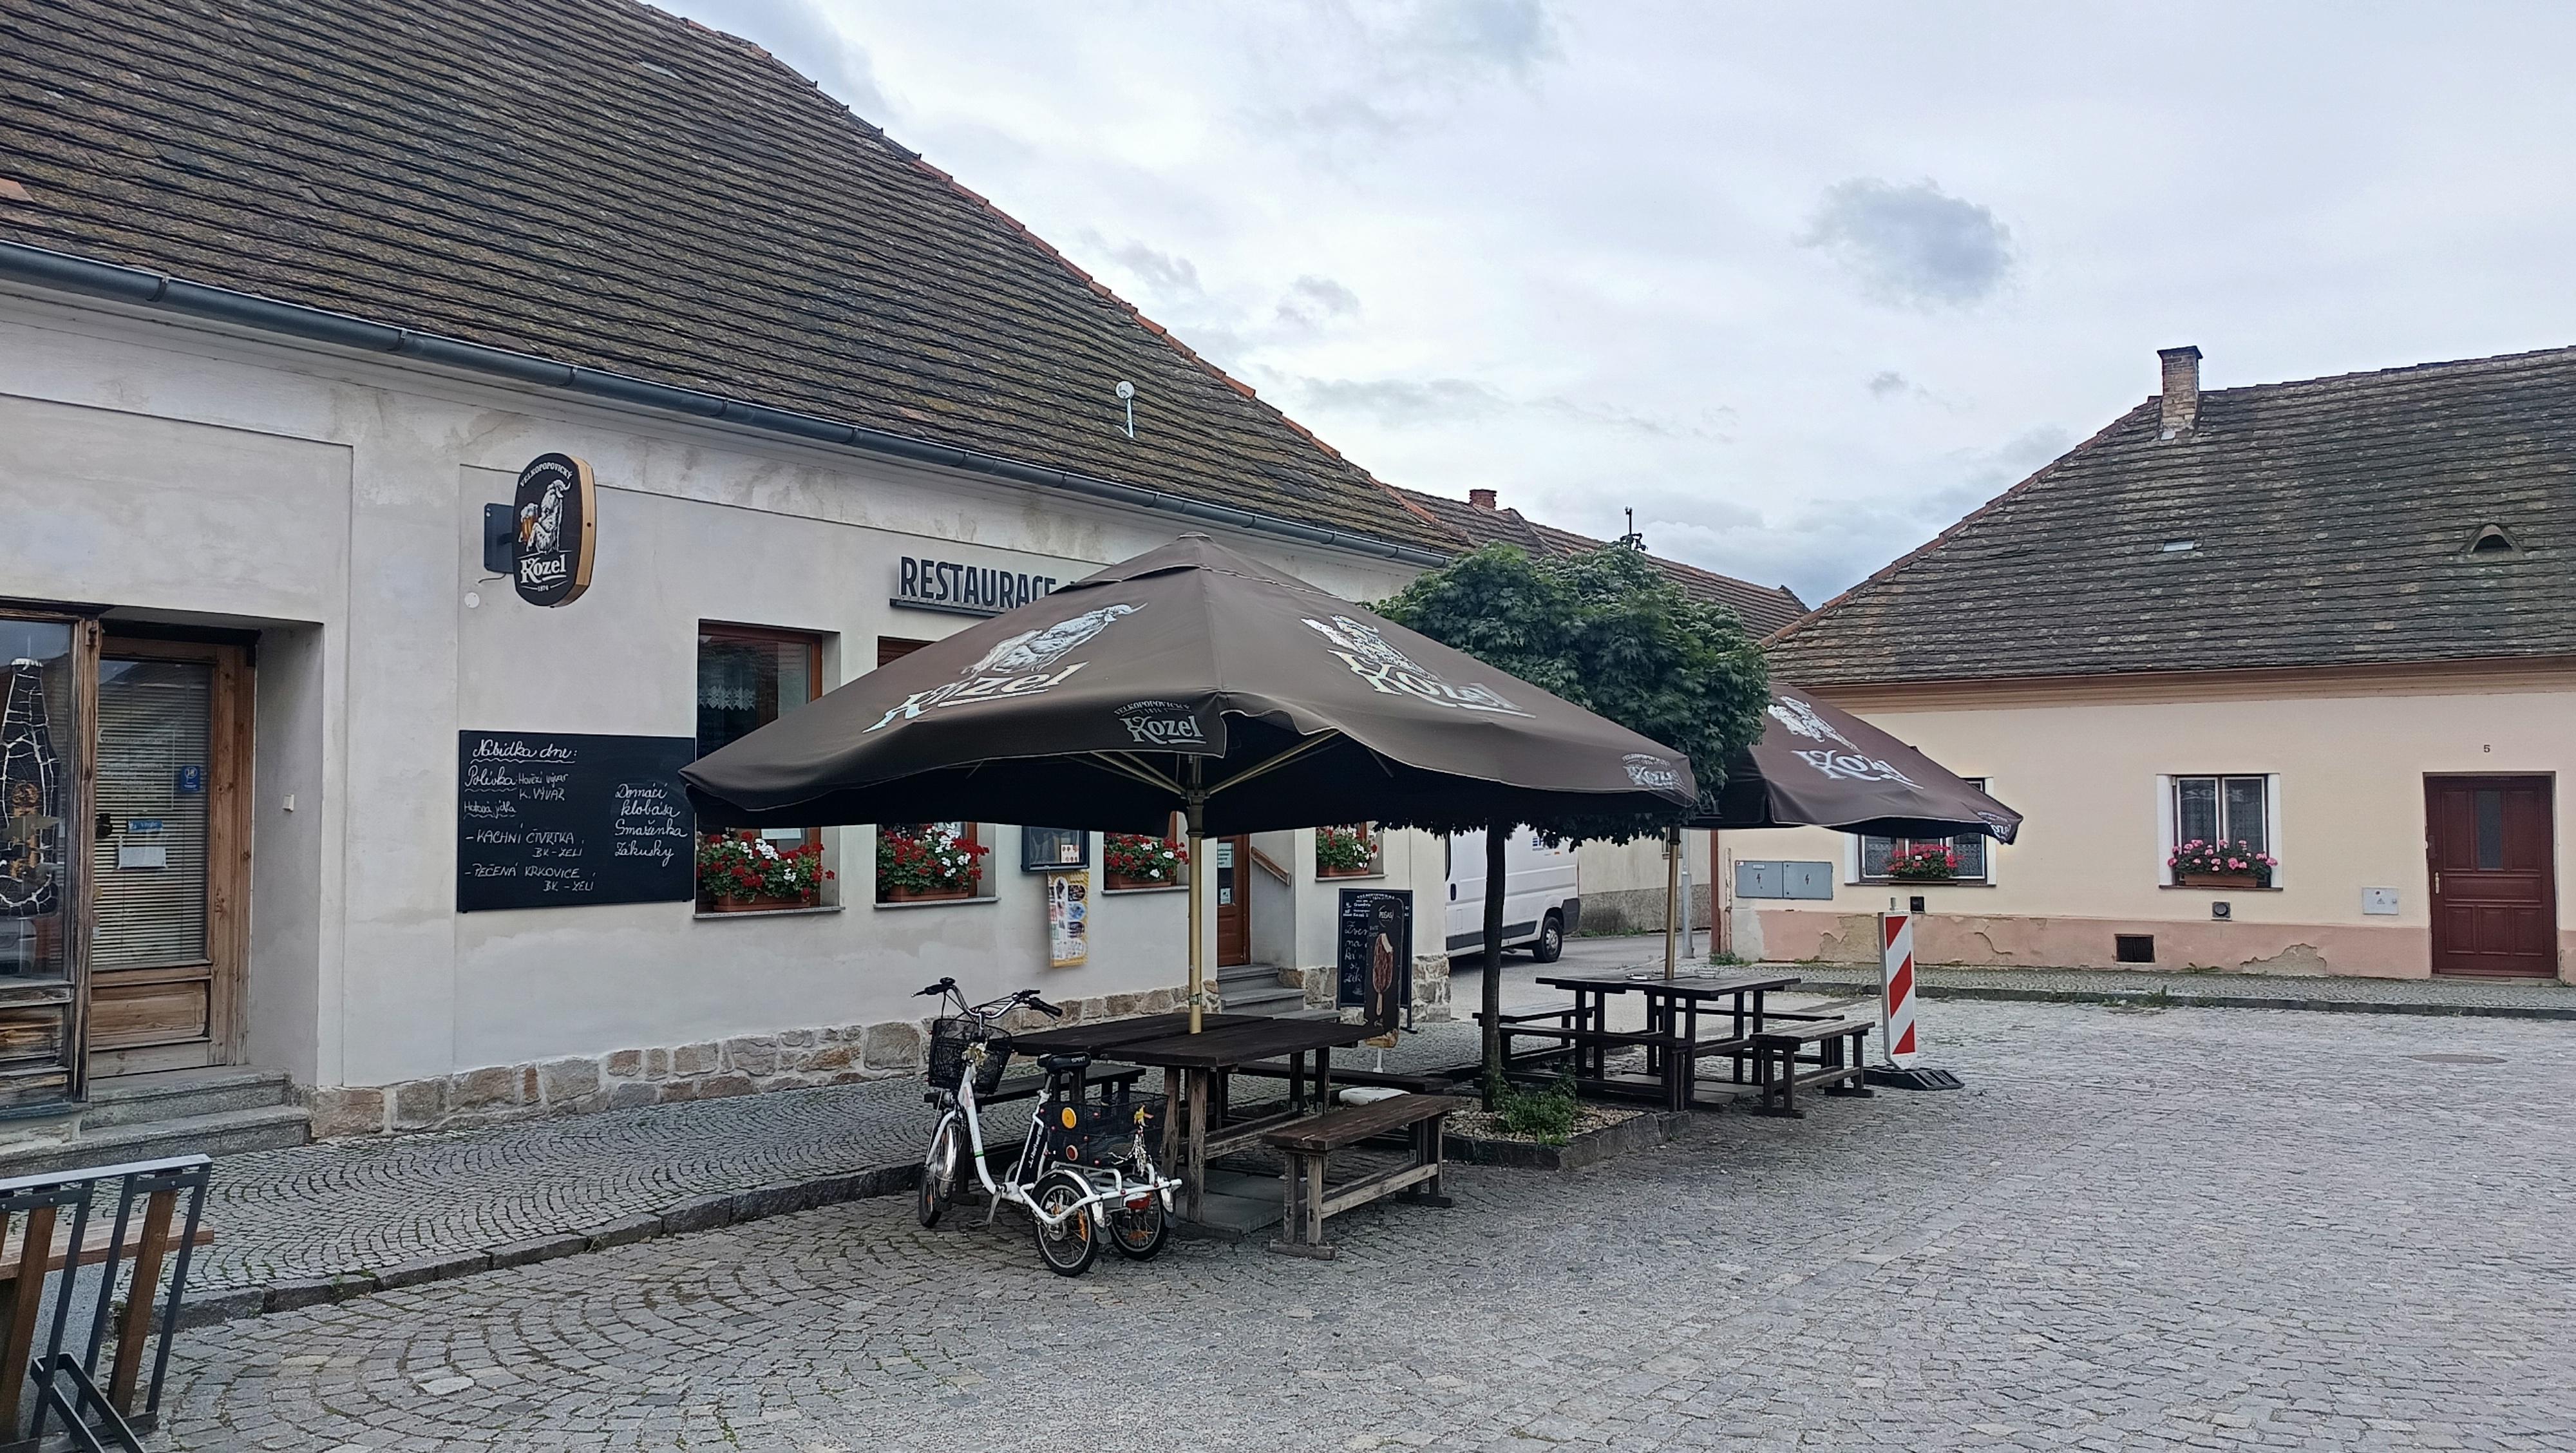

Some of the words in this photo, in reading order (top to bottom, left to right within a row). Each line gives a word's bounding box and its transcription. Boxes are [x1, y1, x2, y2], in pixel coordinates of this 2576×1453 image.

[520, 462, 573, 488] VELKOPOPOVICKÝ
[520, 554, 567, 584] Kozel
[1119, 715, 1204, 745] Kozel
[2484, 745, 2490, 753] 5
[615, 783, 668, 799] Domácí
[614, 839, 674, 867] Zákusky
